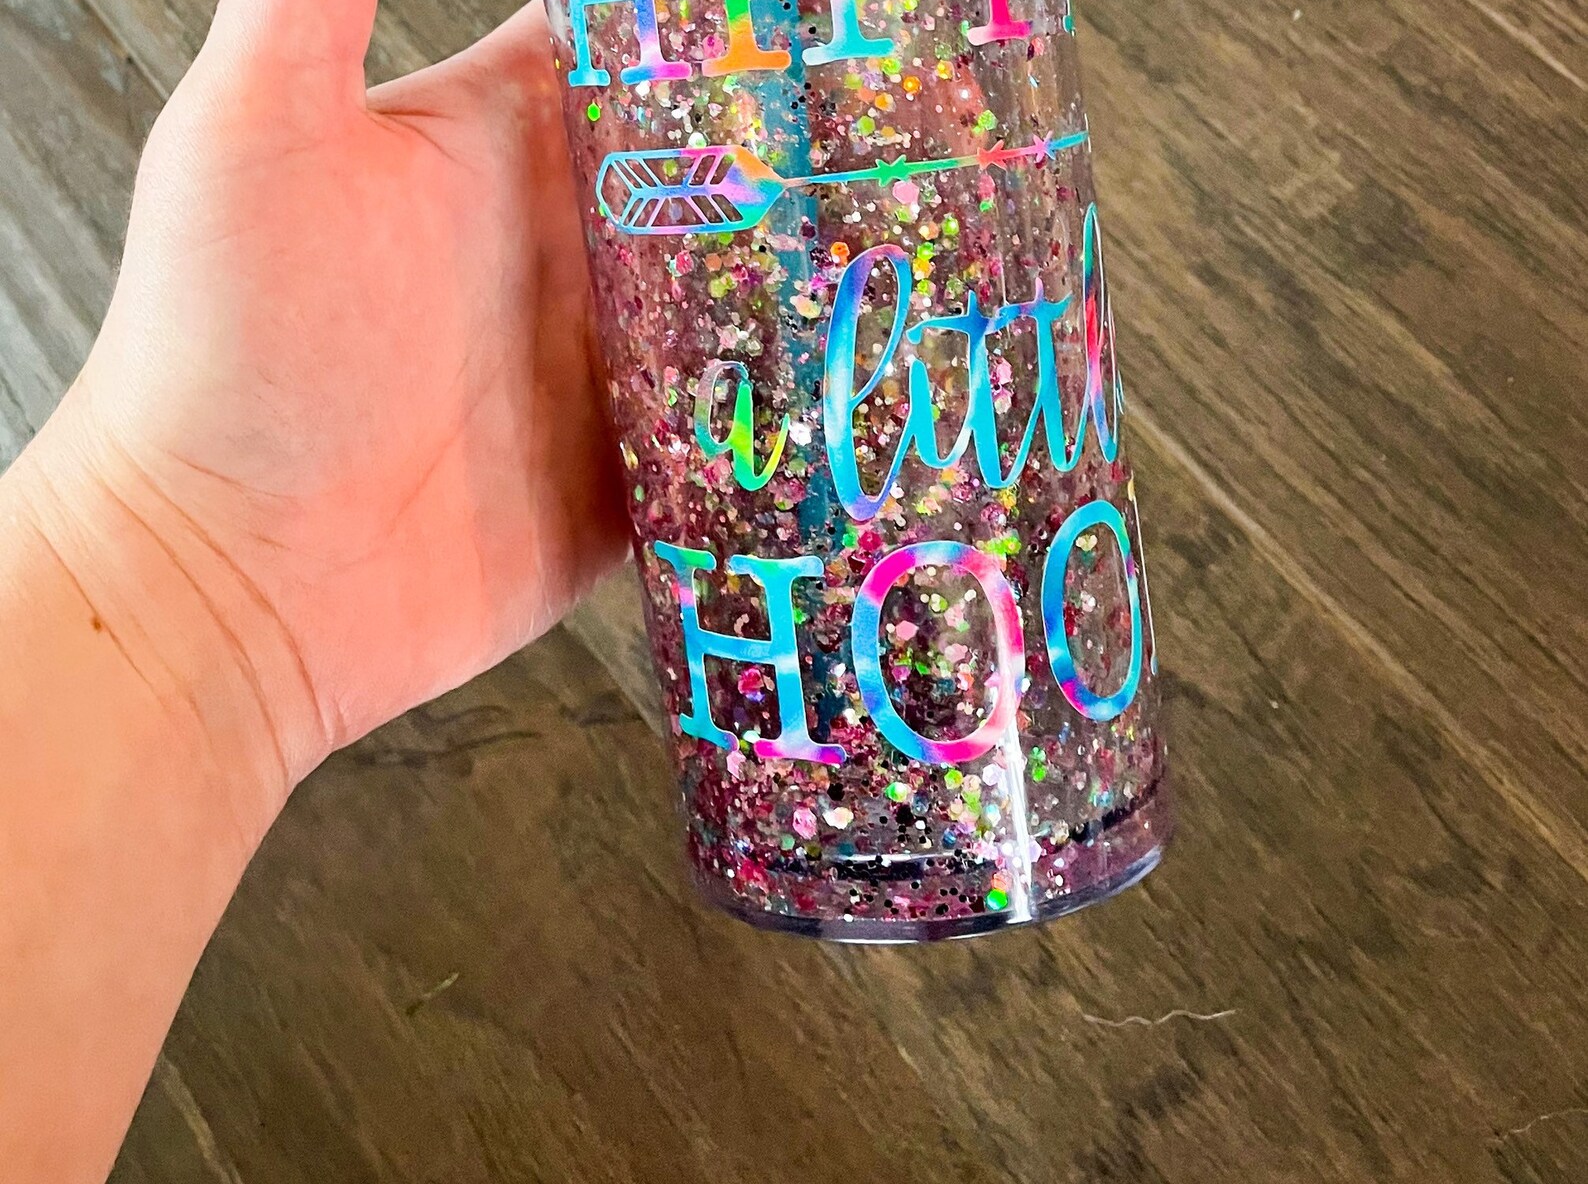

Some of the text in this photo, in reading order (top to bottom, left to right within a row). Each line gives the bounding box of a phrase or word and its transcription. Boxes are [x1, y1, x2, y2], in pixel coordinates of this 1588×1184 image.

[693, 200, 1124, 522] a littl
[654, 470, 1158, 766] HOO
